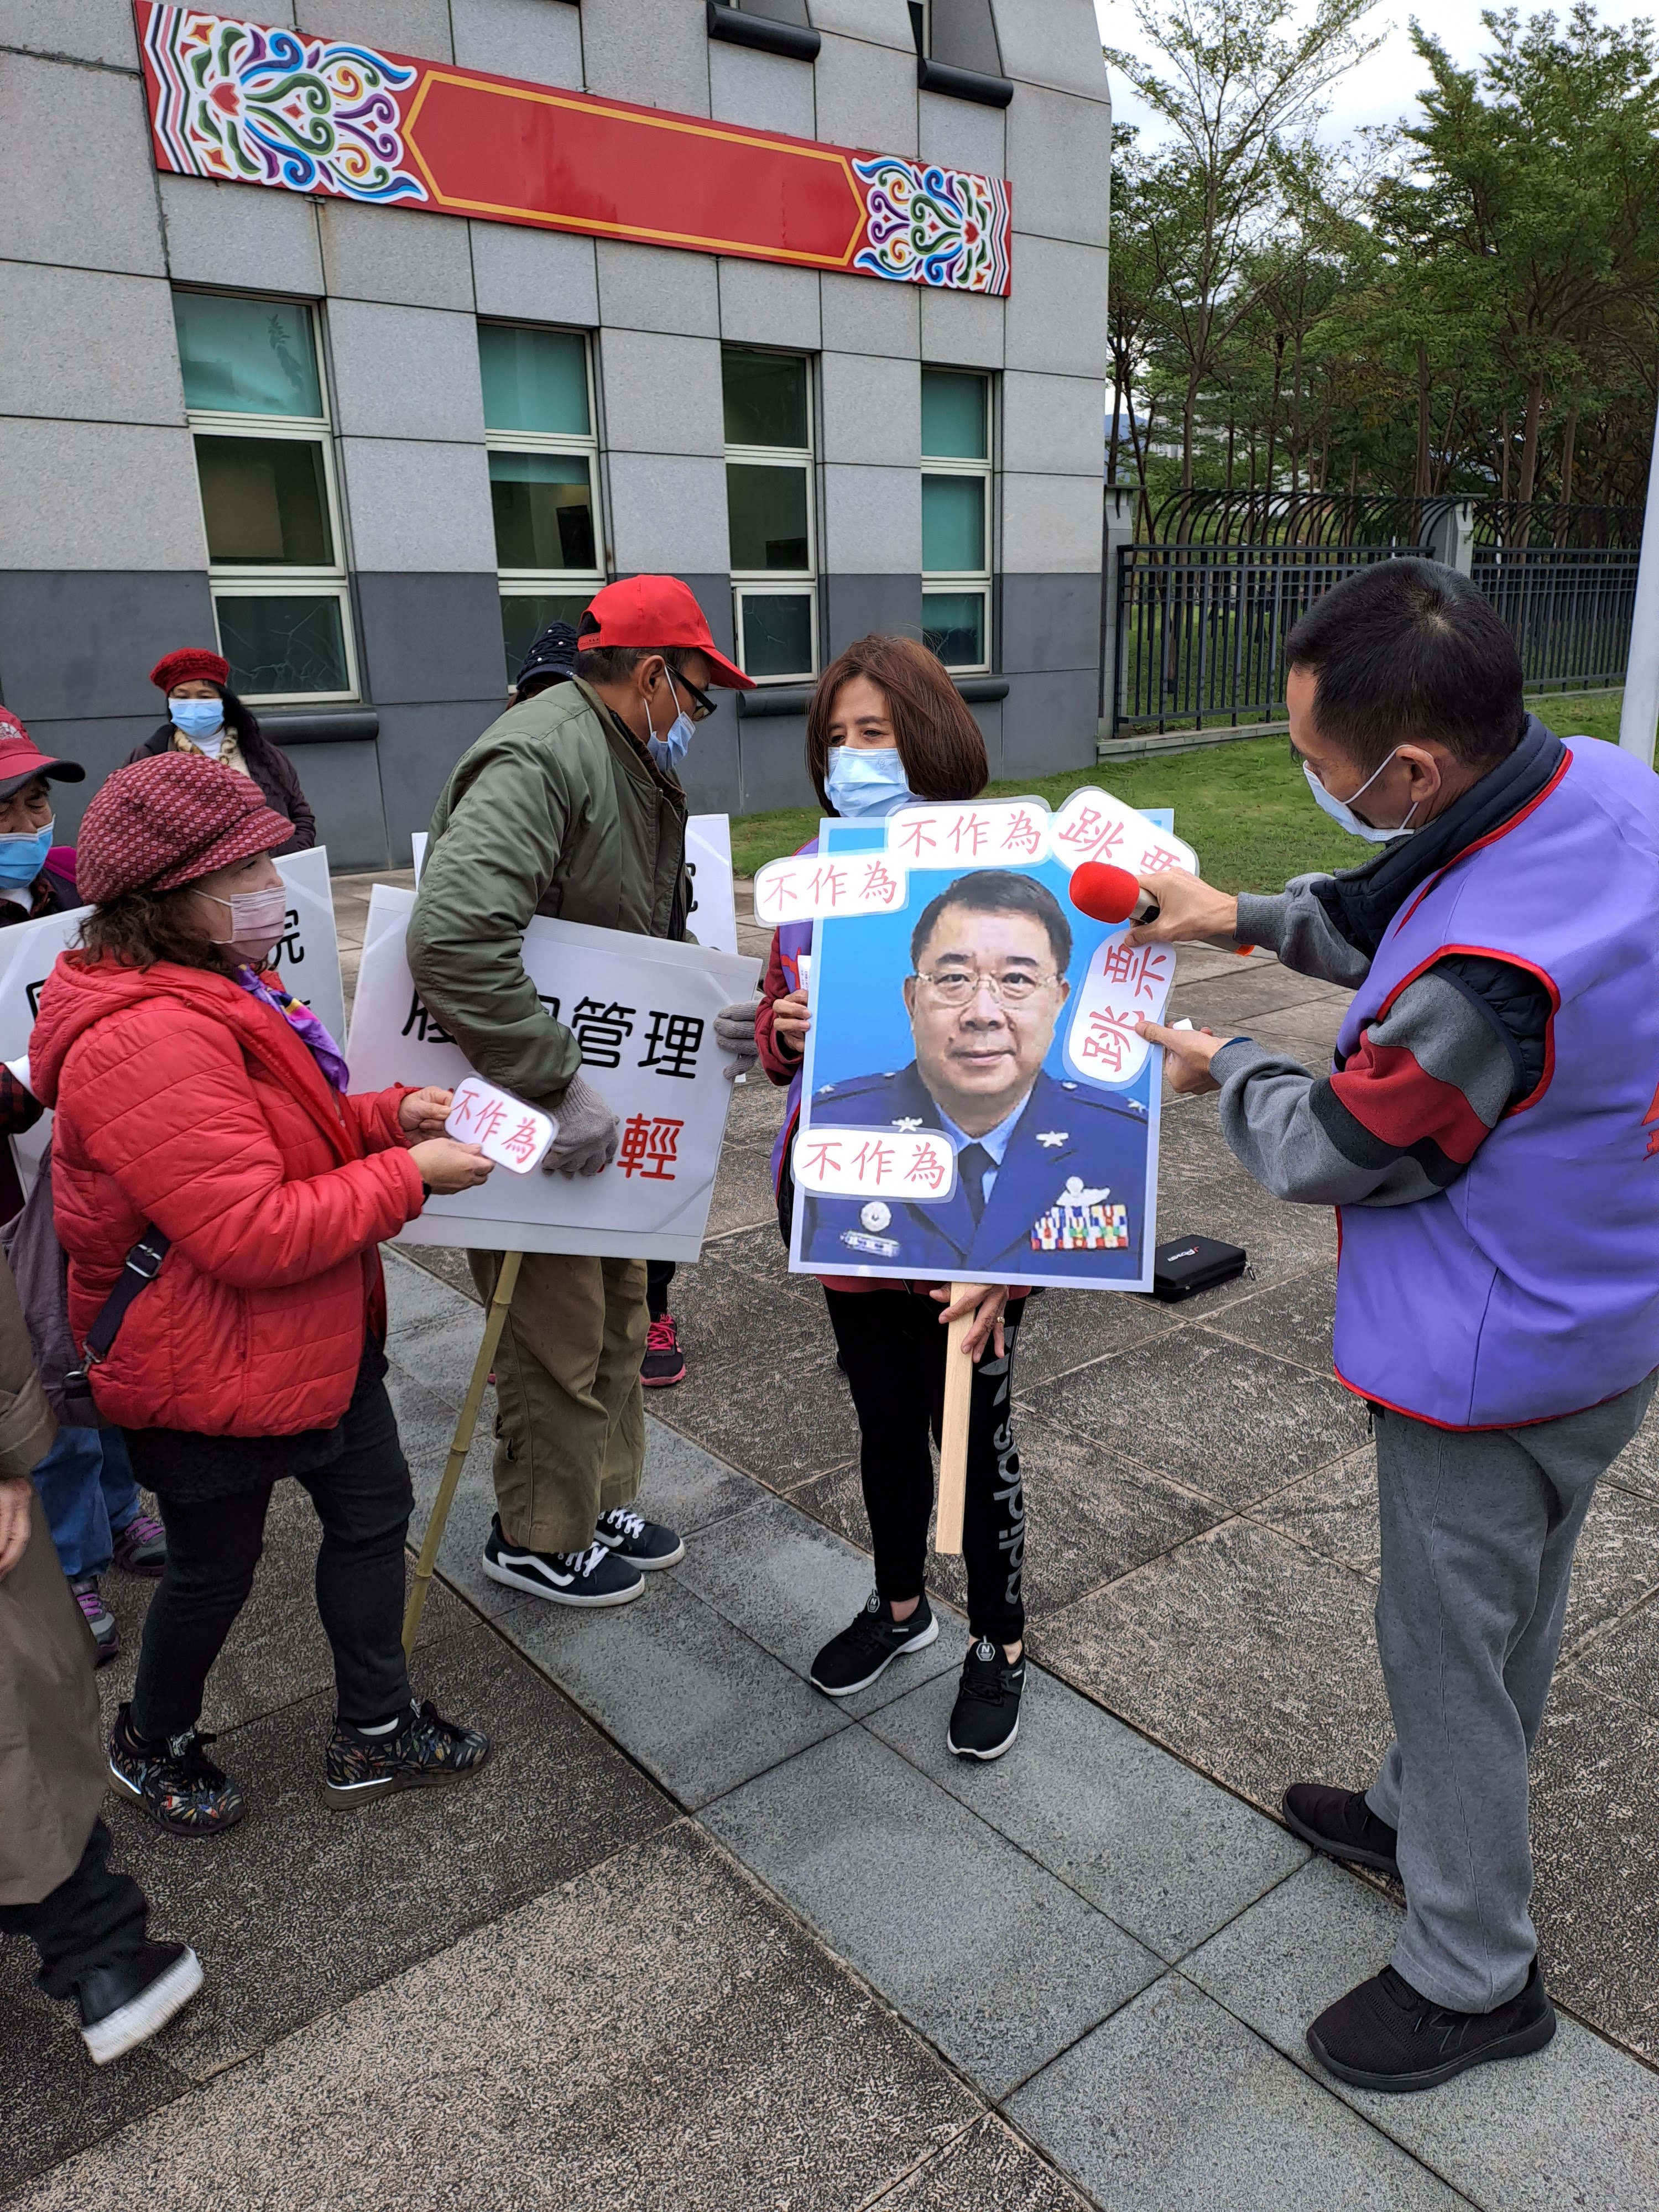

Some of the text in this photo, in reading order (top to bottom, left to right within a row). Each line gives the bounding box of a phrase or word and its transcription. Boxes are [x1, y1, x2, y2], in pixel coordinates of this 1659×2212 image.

[898, 810, 1041, 858] 不作為
[764, 860, 897, 911] 不作為
[1082, 943, 1167, 1072] 跳票
[452, 1089, 536, 1164] 不作為
[801, 1141, 945, 1190] 不作為
[993, 1417, 1024, 1604] adidas
